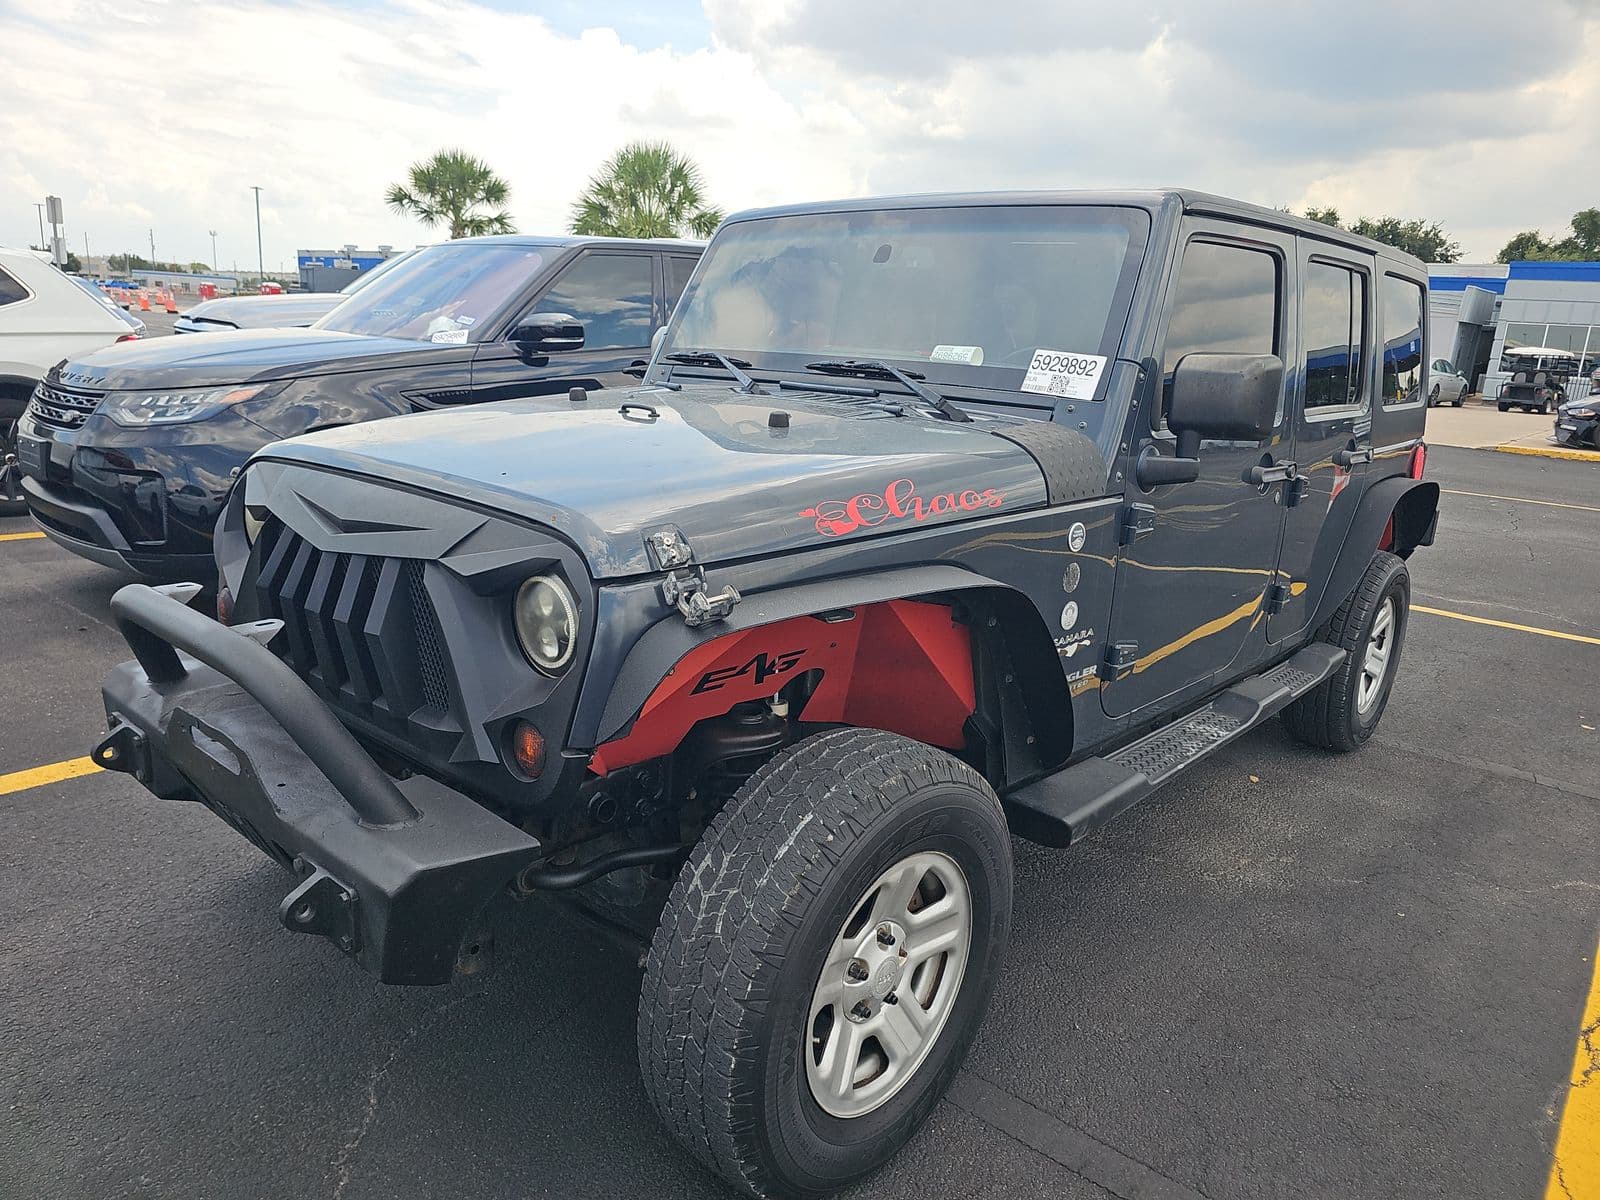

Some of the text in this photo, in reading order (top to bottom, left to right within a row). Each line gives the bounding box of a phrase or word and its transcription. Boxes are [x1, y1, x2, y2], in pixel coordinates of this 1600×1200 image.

[1031, 354, 1098, 377] 5929892
[798, 478, 1007, 537] Chaos
[1053, 627, 1094, 647] SAHARA
